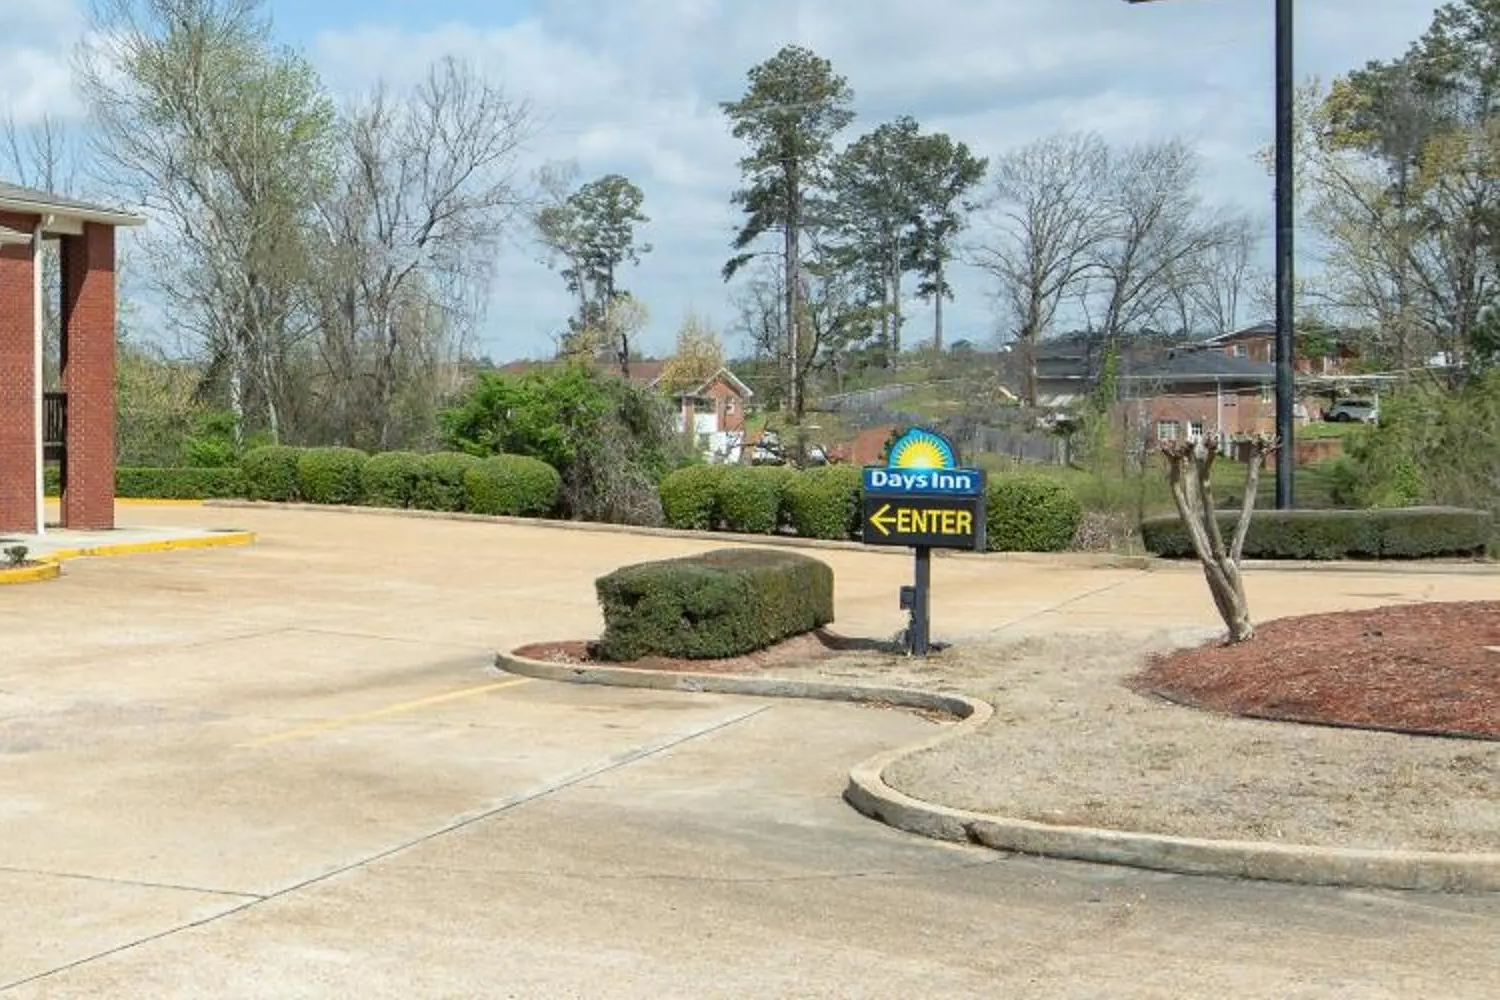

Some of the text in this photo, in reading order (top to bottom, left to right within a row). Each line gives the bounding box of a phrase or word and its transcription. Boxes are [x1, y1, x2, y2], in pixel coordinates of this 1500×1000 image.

[871, 471, 971, 490] Days Inn
[897, 508, 973, 535] ENTER
